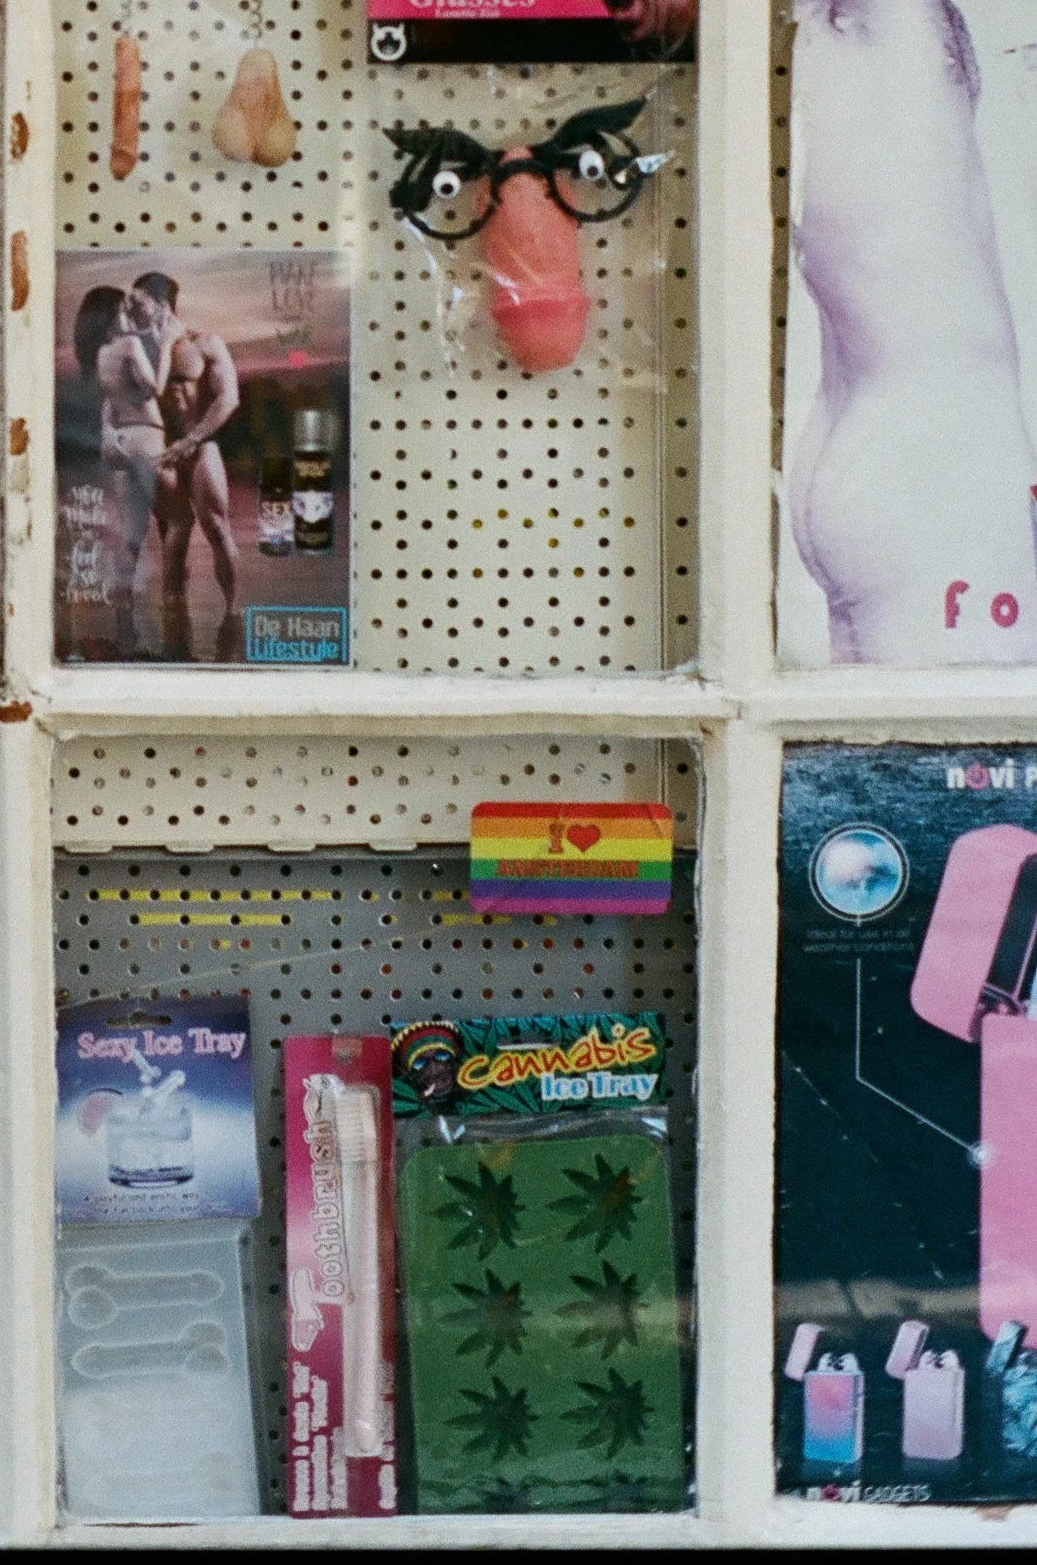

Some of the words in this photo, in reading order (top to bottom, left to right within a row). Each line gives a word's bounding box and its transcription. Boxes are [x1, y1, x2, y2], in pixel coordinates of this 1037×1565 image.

[254, 616, 281, 636] De
[287, 616, 340, 637] Haan
[255, 638, 340, 661] Lifestyle
[549, 823, 564, 854] I
[496, 860, 639, 877] AMSTERDAM
[77, 1032, 136, 1063] Sexy
[143, 1030, 182, 1055] Ice
[188, 1027, 245, 1058] Tray
[541, 1073, 589, 1100] Ice
[587, 1071, 658, 1101] Tray
[290, 1119, 350, 1349] Toothbrush
